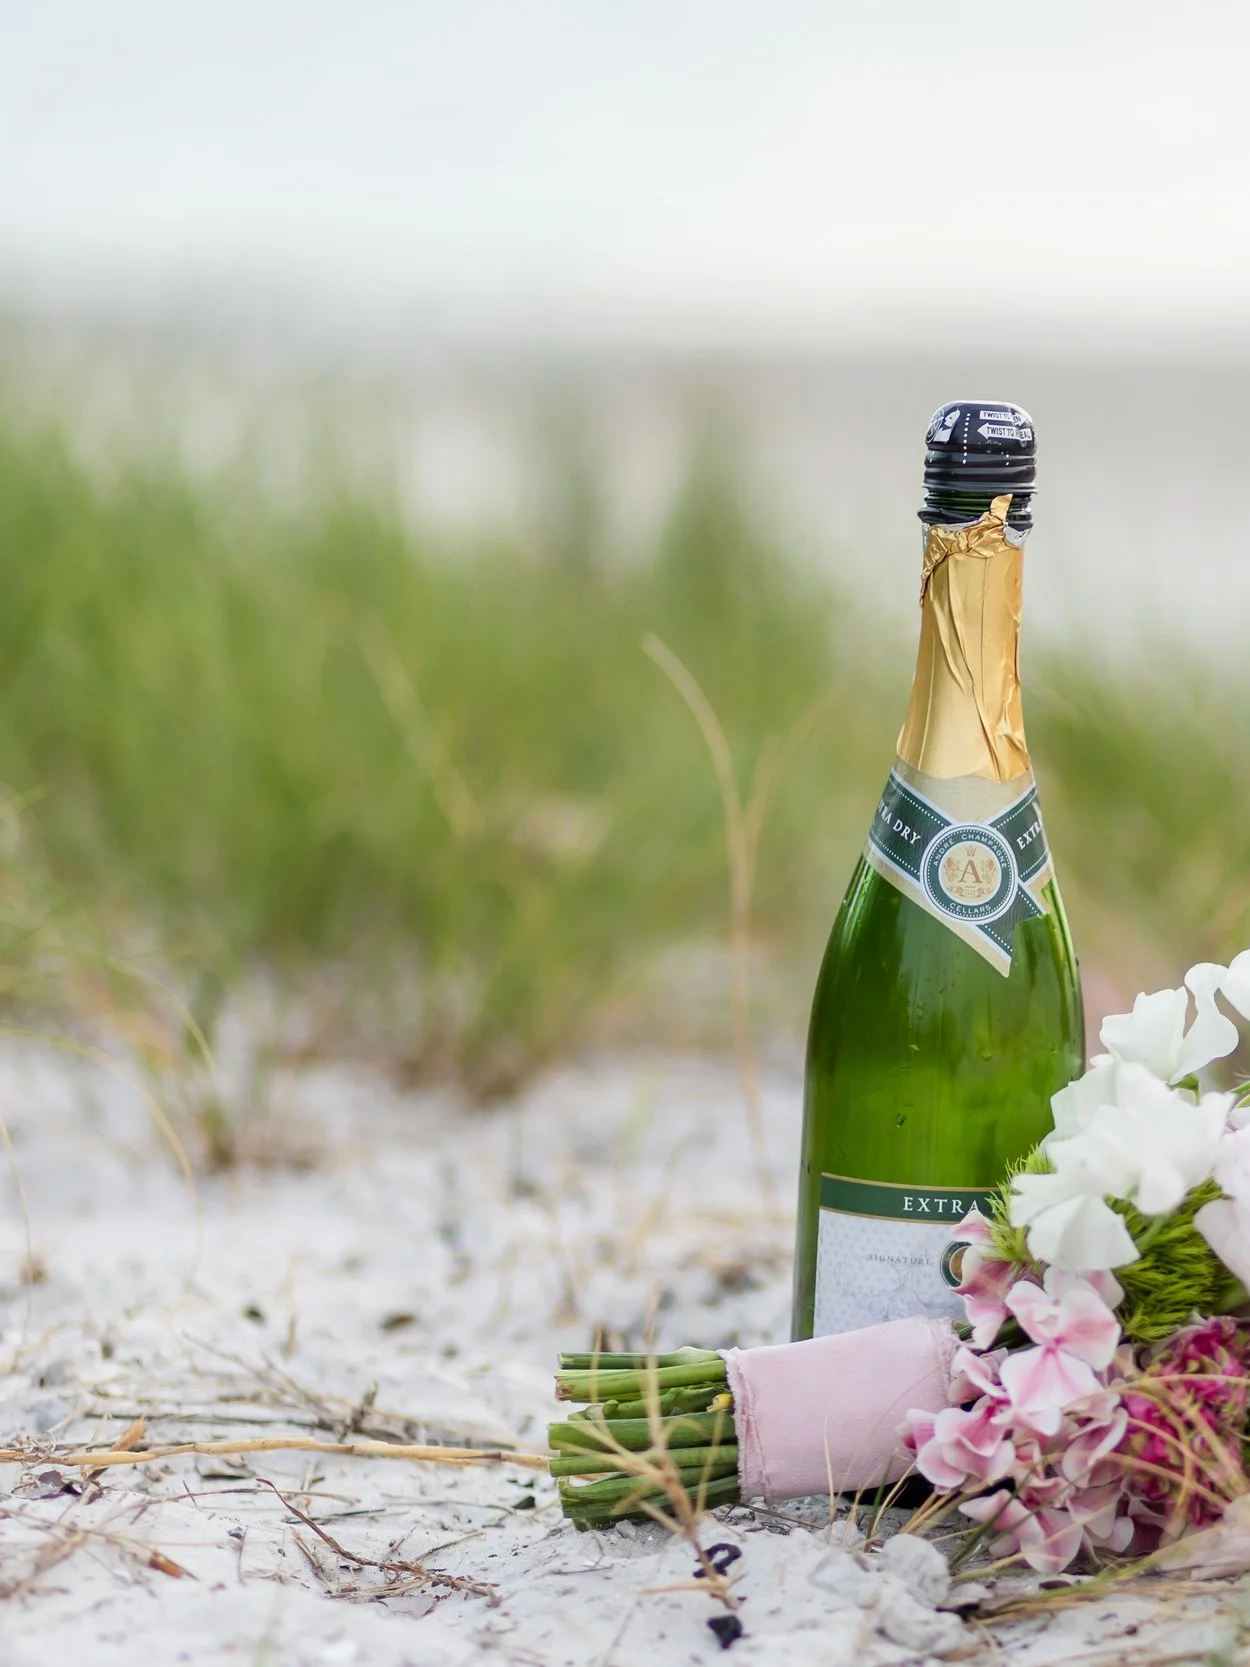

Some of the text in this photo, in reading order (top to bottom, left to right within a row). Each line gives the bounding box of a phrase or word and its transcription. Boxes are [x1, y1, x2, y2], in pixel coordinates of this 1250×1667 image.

[982, 411, 1002, 419] TWIST
[987, 426, 1006, 436] TWIST
[1007, 428, 1015, 437] TO
[893, 819, 921, 844] DRY
[1016, 821, 1041, 850] EXTR
[933, 834, 1008, 868] ANDRÉ CHAMPAGNE
[957, 859, 983, 883] A
[949, 902, 991, 914] CELLARS
[903, 1196, 979, 1213] EXTRA
